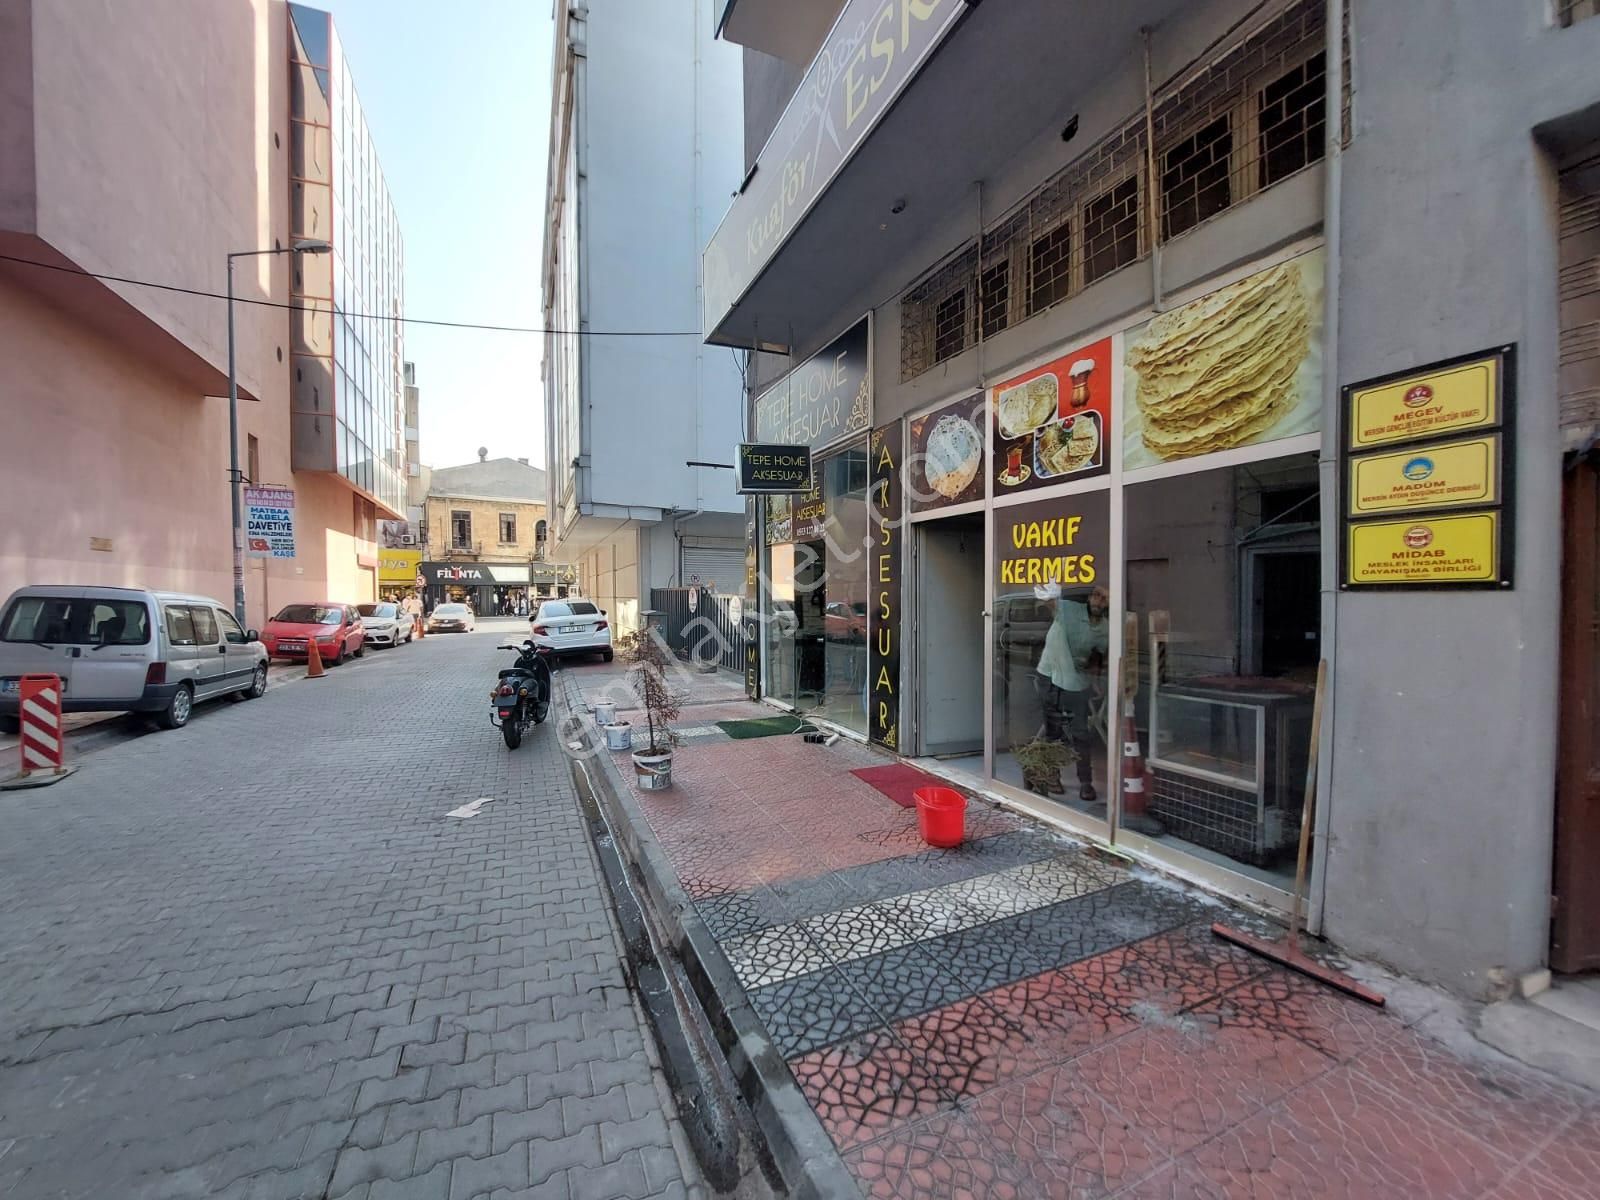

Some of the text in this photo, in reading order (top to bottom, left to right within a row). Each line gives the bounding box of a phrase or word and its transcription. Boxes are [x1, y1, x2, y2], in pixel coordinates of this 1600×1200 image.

[745, 151, 811, 263] Kuaför
[767, 350, 848, 428] TEPE HOME
[1392, 405, 1444, 422] MEGEV
[747, 454, 807, 467] TEPE HOME
[751, 469, 804, 481] AKSESUAR
[1392, 481, 1446, 492] MADÜM
[246, 490, 293, 500] AK AJANS
[251, 513, 290, 521] TABELA
[248, 521, 293, 531] DAVETİYE
[1012, 516, 1082, 549] VAKIF
[1391, 549, 1446, 560] MİDAB
[1001, 554, 1096, 585] KERMES
[1367, 560, 1409, 568] MESLEK
[876, 444, 894, 730] AKSESUAR
